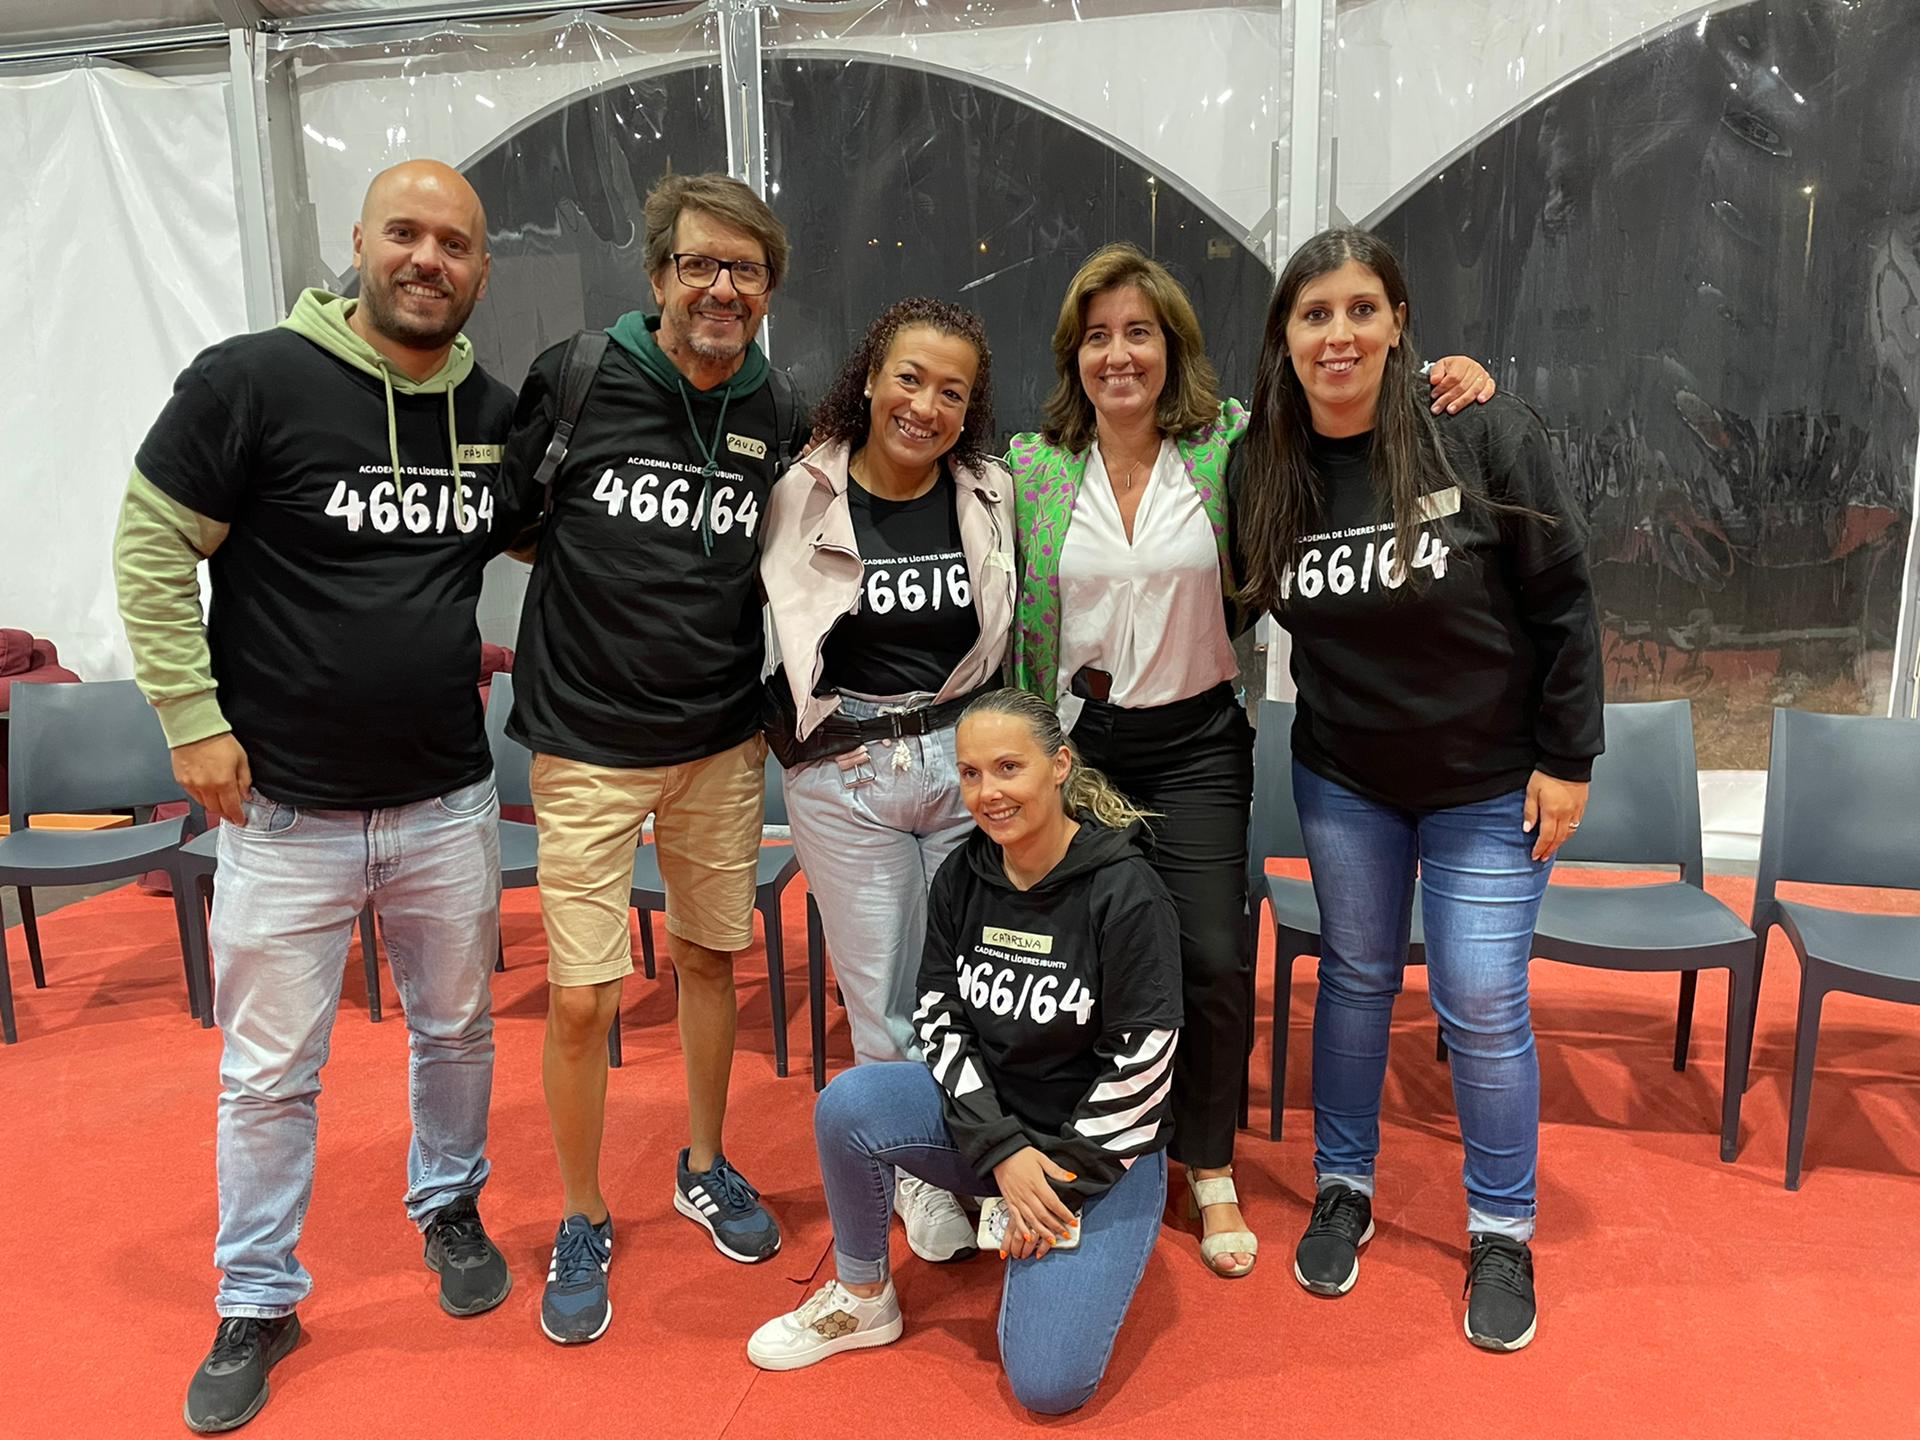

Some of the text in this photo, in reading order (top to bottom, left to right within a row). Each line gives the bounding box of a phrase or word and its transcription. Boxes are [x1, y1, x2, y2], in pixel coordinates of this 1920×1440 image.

[728, 436, 764, 455] PAULO
[359, 465, 477, 479] ACADEMA DE LÍDERES UUNTU
[627, 457, 671, 470] ACADEMIA
[672, 462, 684, 472] DE
[714, 470, 744, 482] UBUNTU
[324, 480, 494, 534] 466/64
[592, 468, 759, 538] 466/64
[1332, 530, 1343, 539] DE
[1344, 525, 1376, 537] LÍDERES
[1377, 521, 1396, 531] UBU
[897, 557, 908, 565] DE
[909, 554, 938, 563] LÍDERES
[854, 564, 973, 615] 66/6
[991, 932, 1042, 949] CATARINA
[974, 945, 1004, 959] CADEMIA
[1011, 954, 1040, 967] LÍDERES
